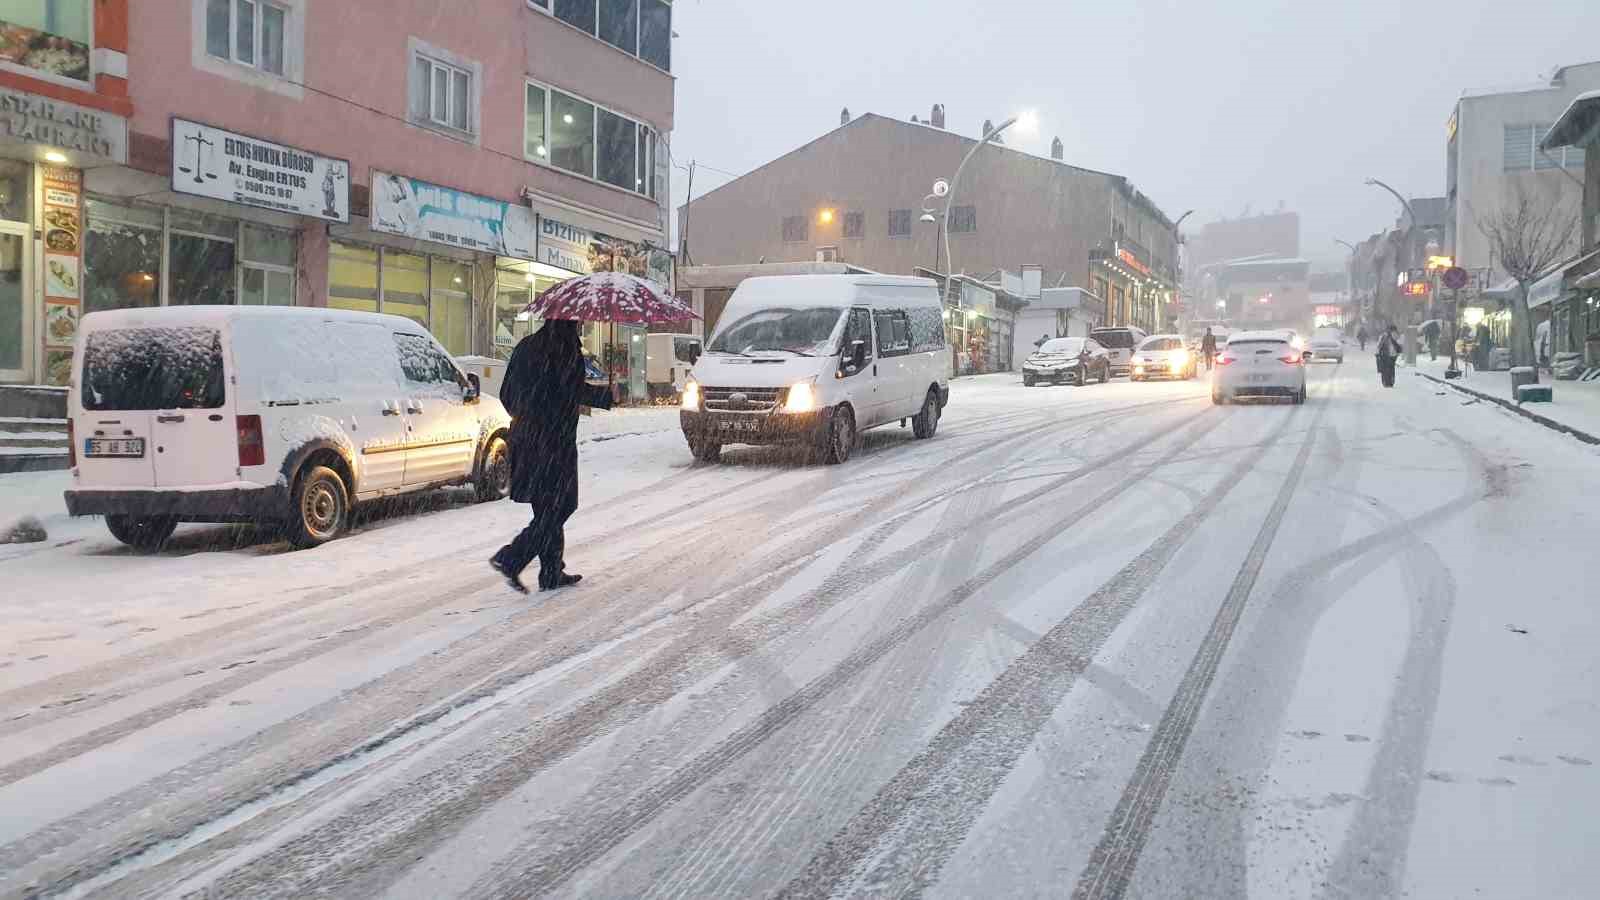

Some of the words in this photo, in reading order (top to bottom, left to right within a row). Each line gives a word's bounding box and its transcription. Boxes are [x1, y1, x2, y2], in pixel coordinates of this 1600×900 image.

[225, 137, 251, 160] ERTUS
[252, 143, 281, 167] HUKUK
[229, 160, 244, 176] Av.
[246, 165, 275, 182] Engin
[276, 171, 307, 189] ERTUS
